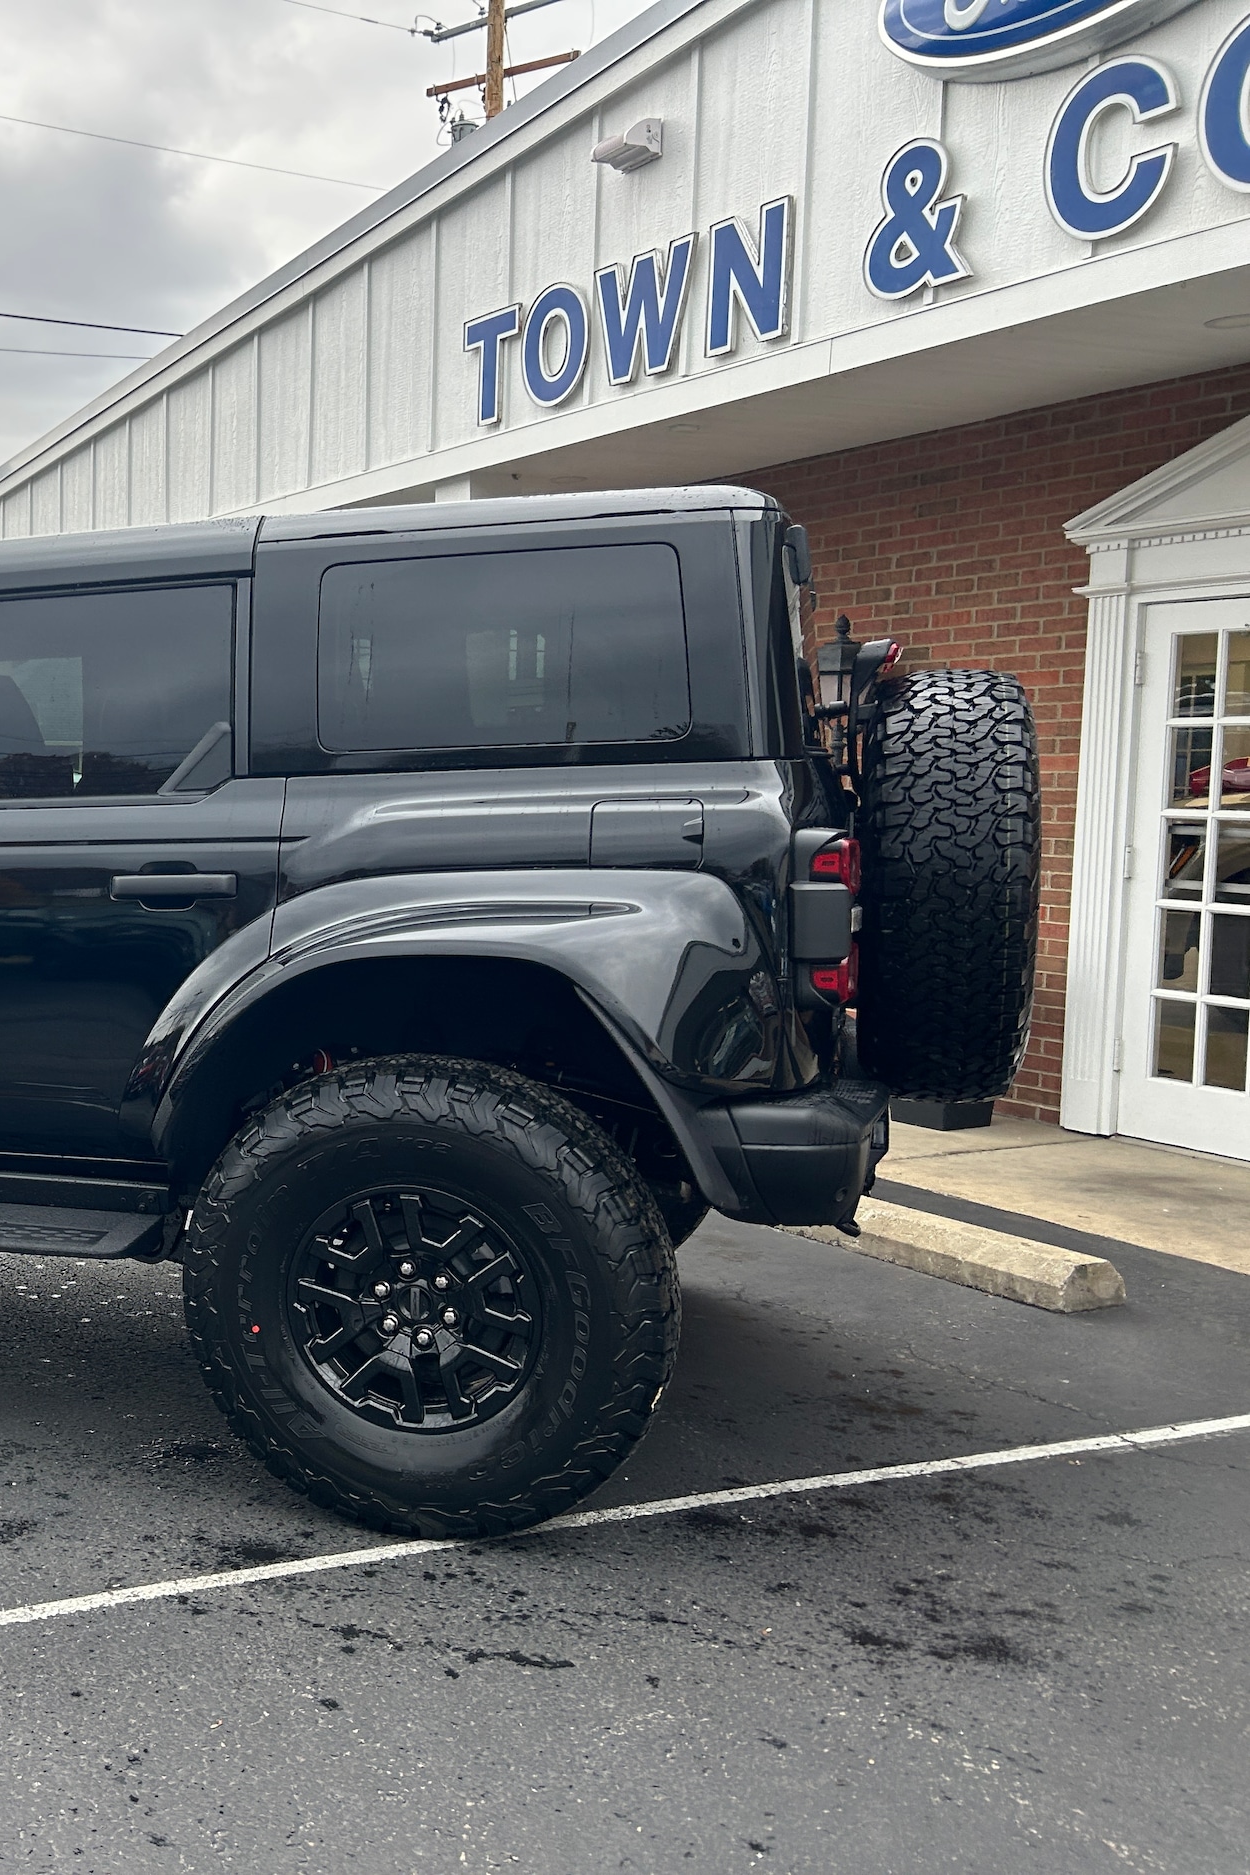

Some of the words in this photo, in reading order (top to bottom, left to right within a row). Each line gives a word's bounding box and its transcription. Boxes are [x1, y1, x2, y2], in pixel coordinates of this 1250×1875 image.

[463, 194, 793, 427] TOWN
[863, 137, 974, 301] &
[468, 1200, 592, 1484] BFGoodrich
